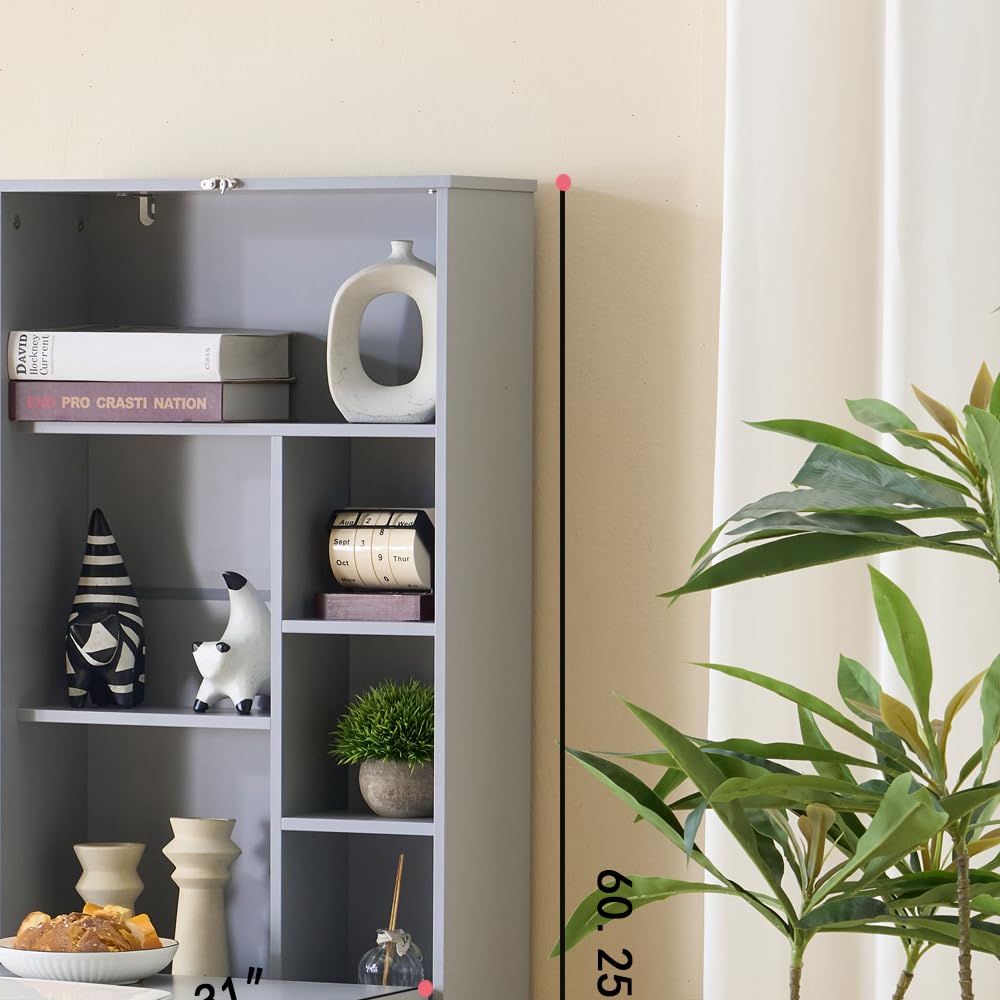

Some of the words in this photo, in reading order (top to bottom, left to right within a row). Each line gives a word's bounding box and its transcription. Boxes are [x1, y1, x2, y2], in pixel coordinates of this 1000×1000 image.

[16, 334, 27, 375] DAVID
[29, 334, 40, 375] Hockney
[40, 335, 50, 376] Current
[62, 396, 90, 409] PRO
[96, 397, 147, 409] CRASTI
[154, 397, 207, 410] NATION
[333, 538, 350, 546] Sept
[360, 539, 366, 547] 3
[377, 553, 383, 561] 9
